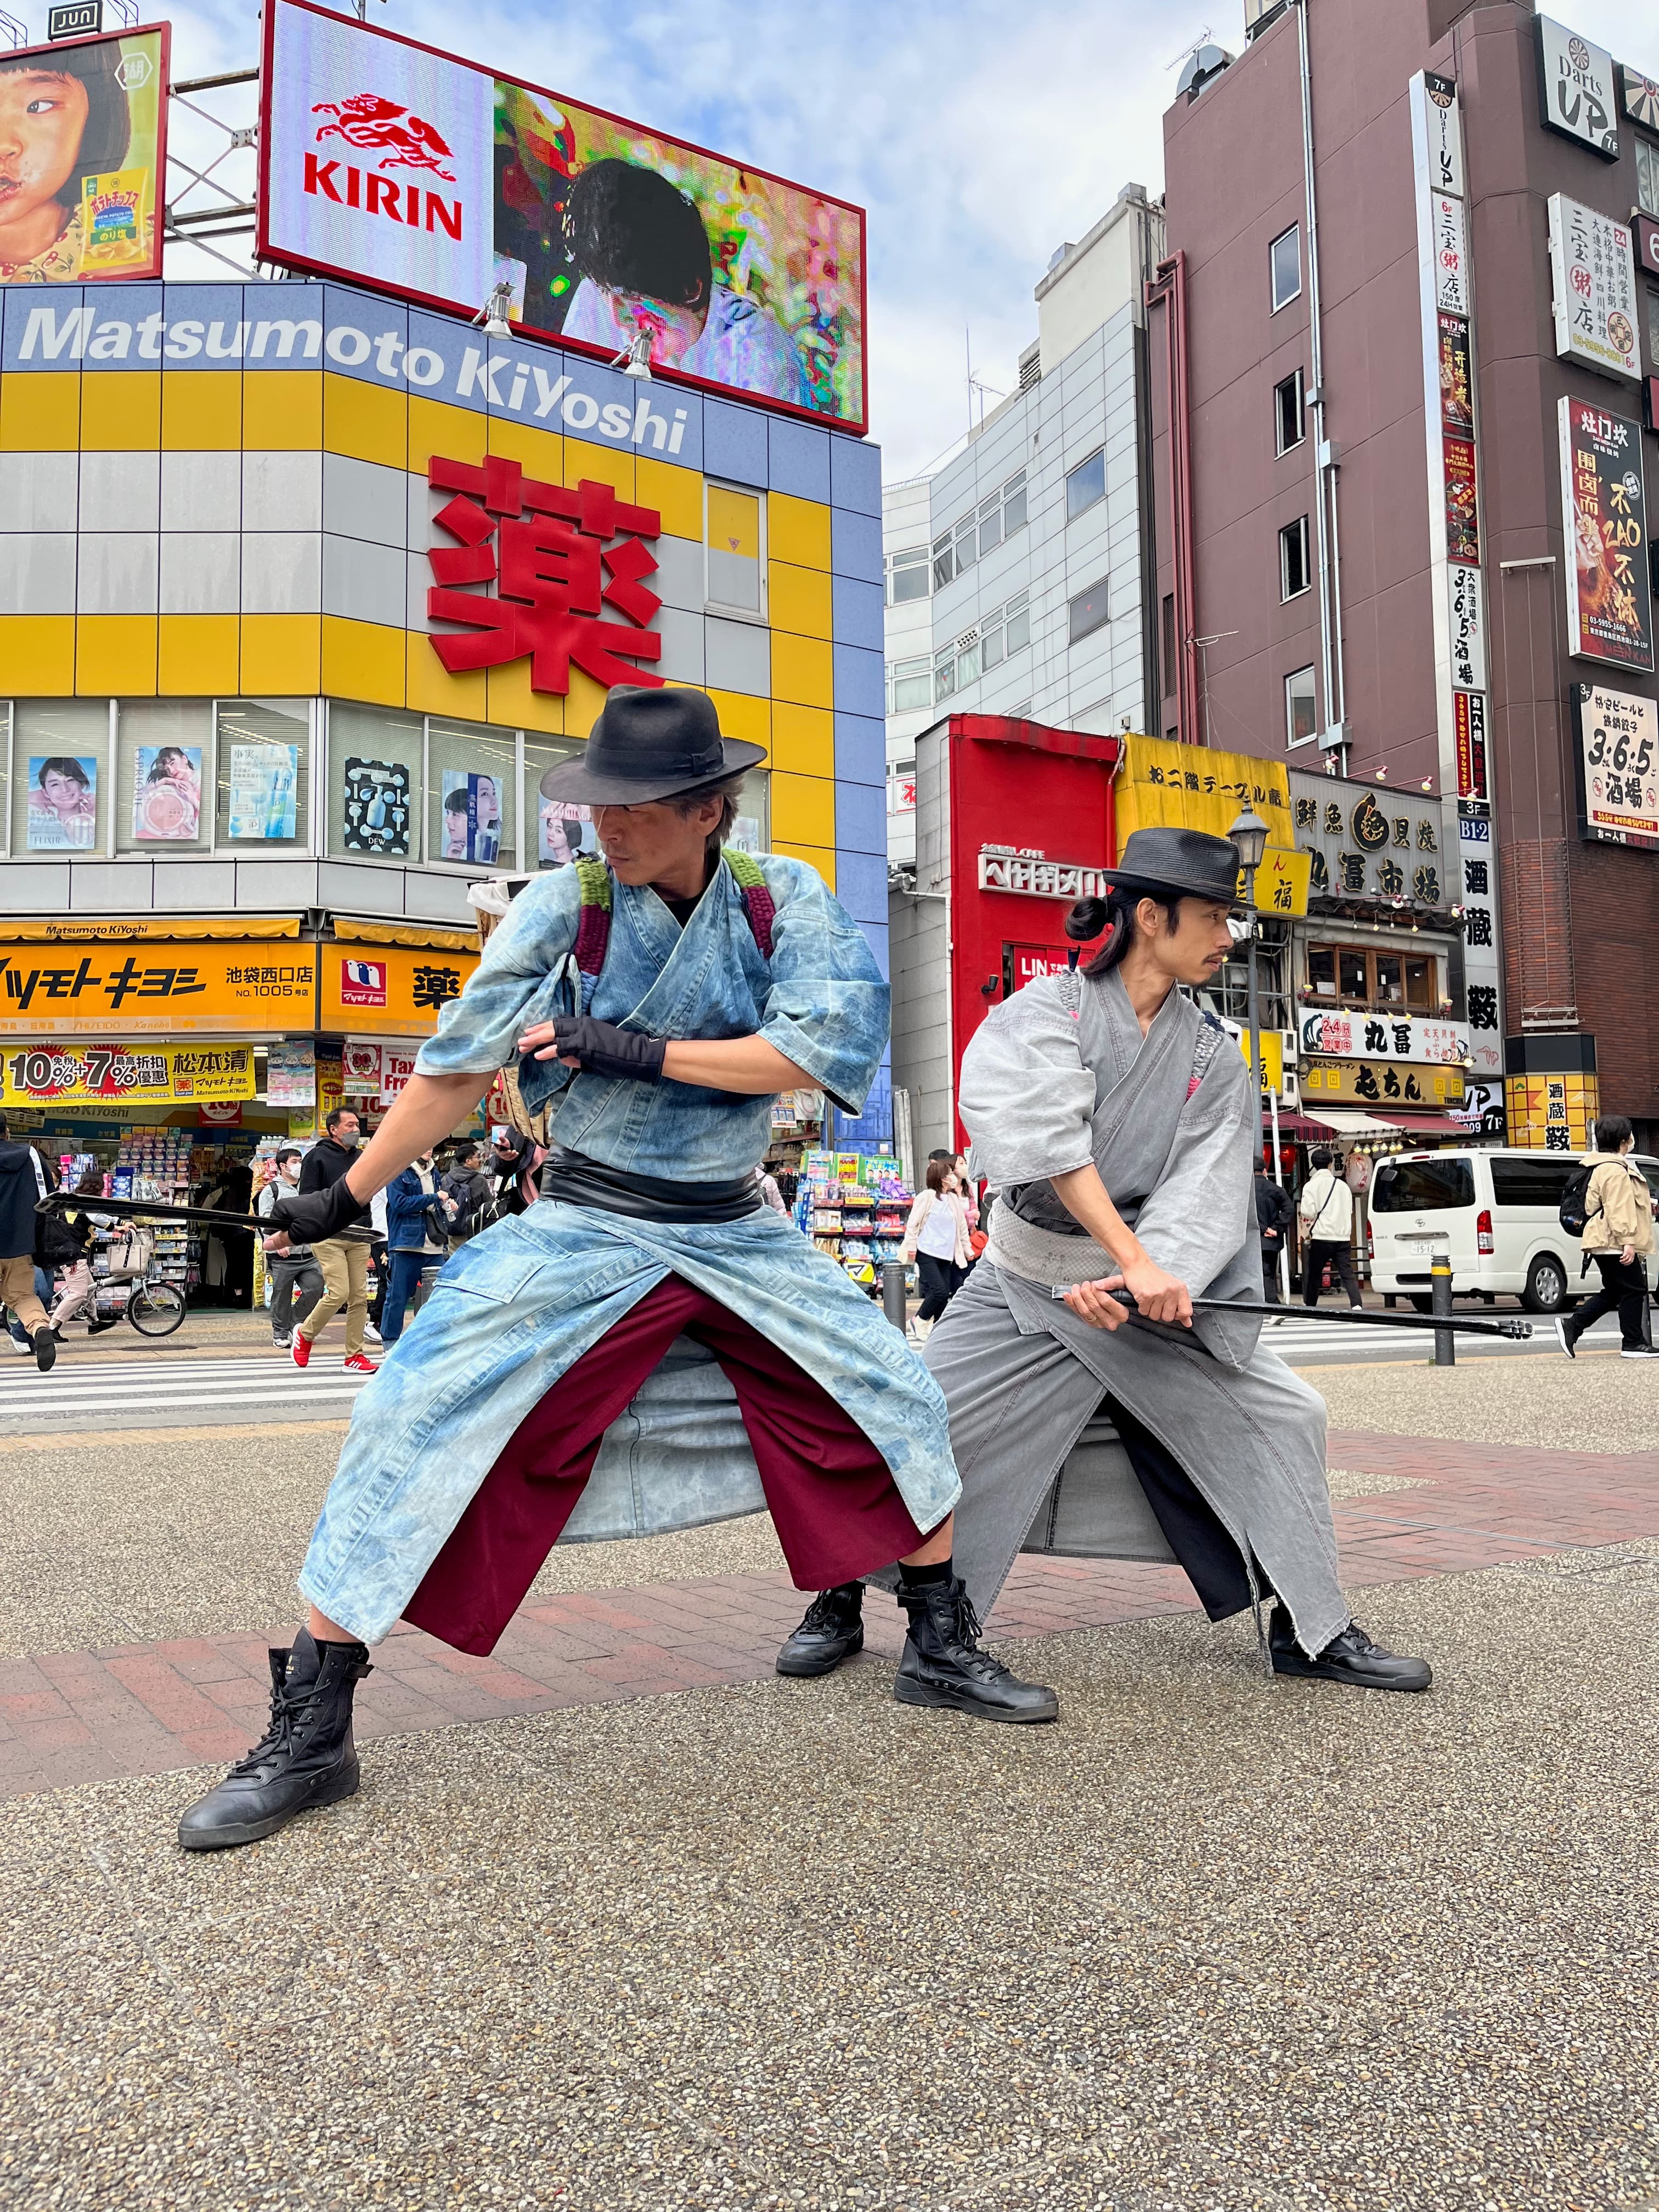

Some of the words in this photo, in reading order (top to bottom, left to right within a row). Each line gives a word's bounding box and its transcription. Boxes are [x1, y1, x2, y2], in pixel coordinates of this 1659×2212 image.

[58, 10, 91, 27] JUN
[1558, 54, 1602, 97] Darts
[1434, 78, 1446, 92] 7F
[1558, 80, 1609, 137] UP
[1605, 135, 1618, 152] 7F
[1440, 150, 1453, 187] UP
[90, 190, 140, 215] ポテトチップス
[304, 151, 462, 241] KIRIN
[1441, 201, 1453, 213] 6F
[99, 229, 127, 241] のり塩
[1571, 209, 1594, 335] 三宝粥店
[1626, 356, 1635, 369] 6F
[18, 306, 444, 387] Matsumoto
[455, 346, 688, 454] KiYoshi
[427, 455, 667, 696] 薬
[1579, 683, 1591, 700] 3F
[1148, 765, 1282, 807] お二階テーブル席
[1605, 771, 1643, 810] 酒場
[1295, 796, 1345, 834] 鮮魚
[1466, 802, 1481, 815] 3F
[34, 836, 61, 844] ELIXIR
[368, 837, 386, 845] DEW
[1272, 854, 1286, 871] ん
[1273, 879, 1293, 911] 福
[1464, 859, 1493, 947] 酒蔵
[46, 926, 108, 935] Matsumoto
[109, 925, 148, 935] KiYoshi
[225, 966, 313, 984] 池袋西口店
[413, 966, 461, 1010] 薬
[343, 992, 385, 1005] マツモトキヨシ
[30, 1022, 55, 1030] 日用品
[133, 1021, 170, 1029] Kanebo
[1321, 1019, 1351, 1036] 24H
[1322, 1038, 1352, 1053] 営業中
[115, 1056, 135, 1065] 最高
[136, 1055, 165, 1069] 折扣
[173, 1049, 249, 1075] 松本清
[388, 1058, 415, 1074] Tax
[195, 1076, 248, 1088] マツモトキヨシ
[1549, 1084, 1565, 1120] 酒蔵
[1485, 1114, 1503, 1131] 7F
